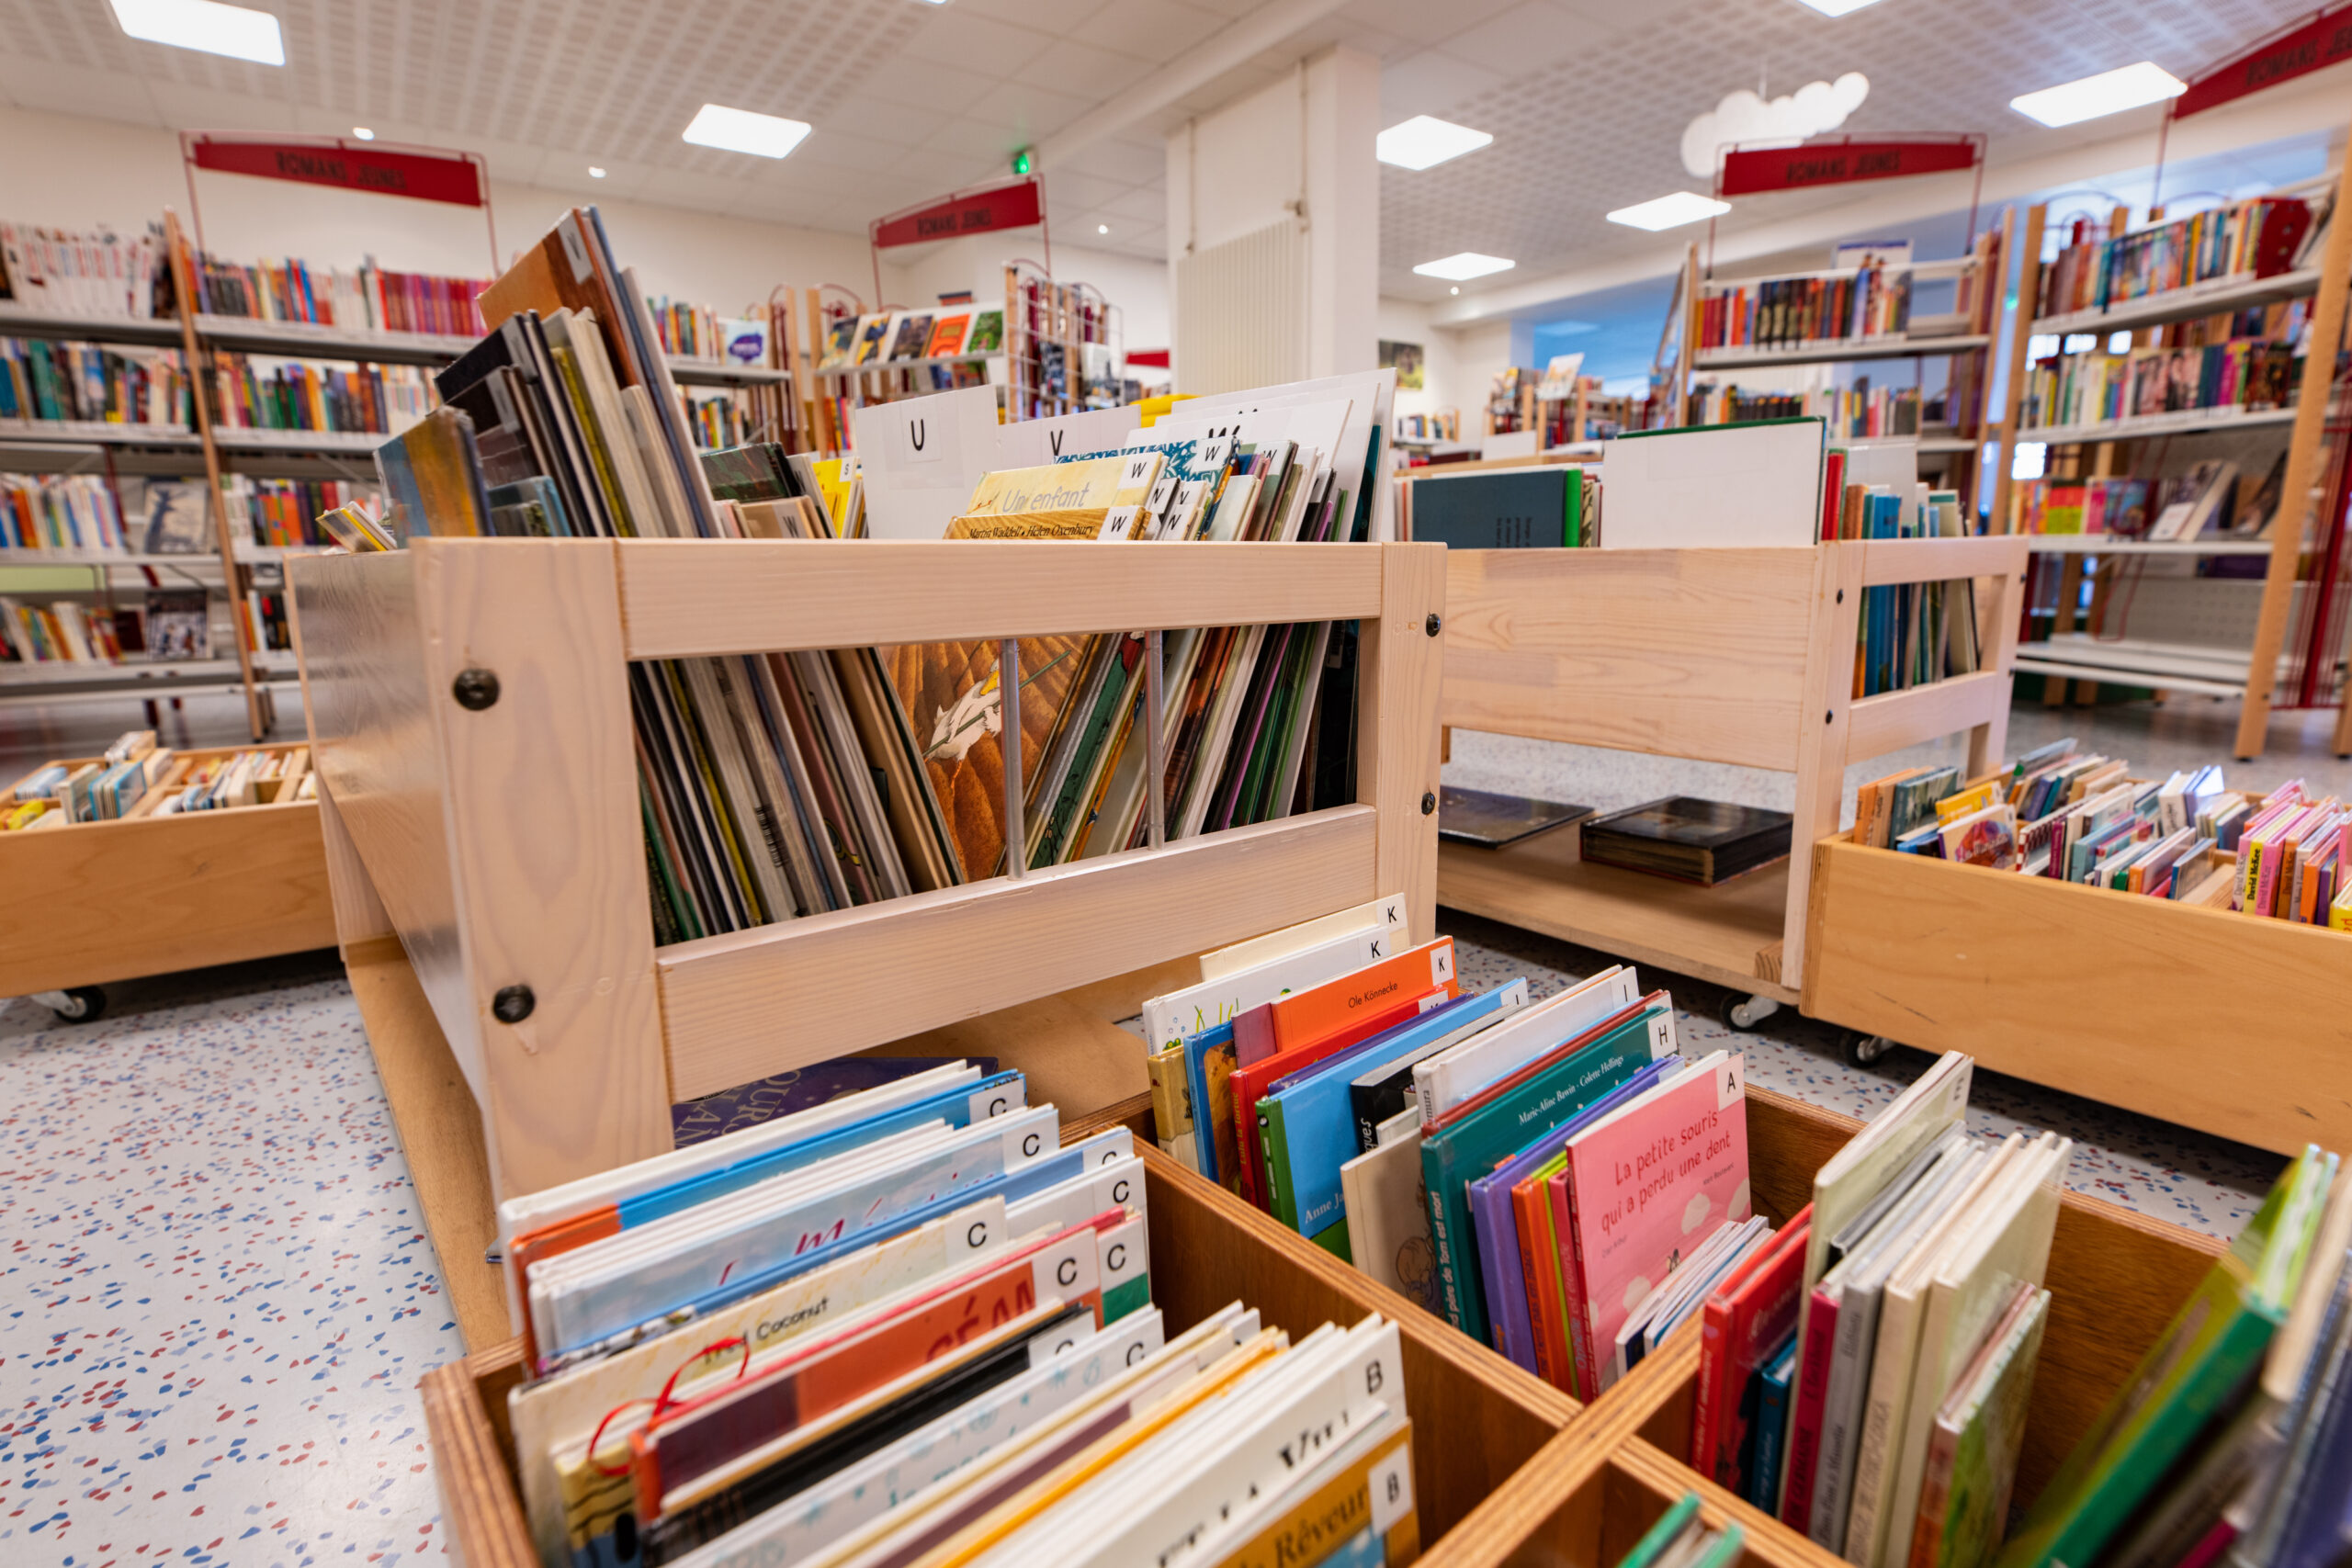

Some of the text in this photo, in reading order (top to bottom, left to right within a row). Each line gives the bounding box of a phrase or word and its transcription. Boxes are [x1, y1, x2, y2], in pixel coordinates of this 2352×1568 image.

[276, 152, 407, 190] ROMANS JEUNES
[1786, 148, 1901, 182] ROMANS JEUNES
[910, 419, 925, 451] U
[1050, 429, 1064, 457] V
[1204, 445, 1221, 462] W
[1131, 461, 1147, 479] W
[1002, 481, 1091, 513] Un enfant
[969, 524, 1096, 541] Martin Waddell Helen Oxenbury
[1111, 515, 1127, 533] W
[2247, 849, 2261, 900] David McKee
[1387, 906, 1397, 923] K
[1370, 940, 1382, 959] K
[1438, 956, 1445, 972] K
[1348, 980, 1398, 1010] Ole Könnecke
[1658, 1024, 1668, 1046] H
[1518, 1097, 1556, 1126] Marie-Aline
[1555, 1084, 1577, 1106] Bawin
[1579, 1066, 1600, 1088] Colette
[1600, 1054, 1624, 1078] Hellings
[1726, 1071, 1736, 1094] A
[989, 1098, 1007, 1118] C
[1022, 1134, 1040, 1157] C
[1360, 1117, 1378, 1155] ques
[1614, 1110, 1719, 1186] La petite souris
[1113, 1180, 1130, 1204] C
[1600, 1129, 1732, 1237] qui a perdu une dent
[1305, 1199, 1332, 1224] Anne
[1430, 1190, 1444, 1220] mort
[967, 1222, 987, 1247] C
[1434, 1221, 1447, 1239] est
[1107, 1244, 1126, 1270] C
[1439, 1240, 1451, 1265] Tom
[1057, 1258, 1077, 1286] C
[1442, 1267, 1453, 1283] de
[1445, 1284, 1460, 1313] père
[756, 1296, 830, 1341] Coconut
[1126, 1341, 1145, 1368] C
[1366, 1359, 1383, 1395] B
[1386, 1472, 1400, 1505] B
[1272, 1480, 1370, 1568] Rêveur
